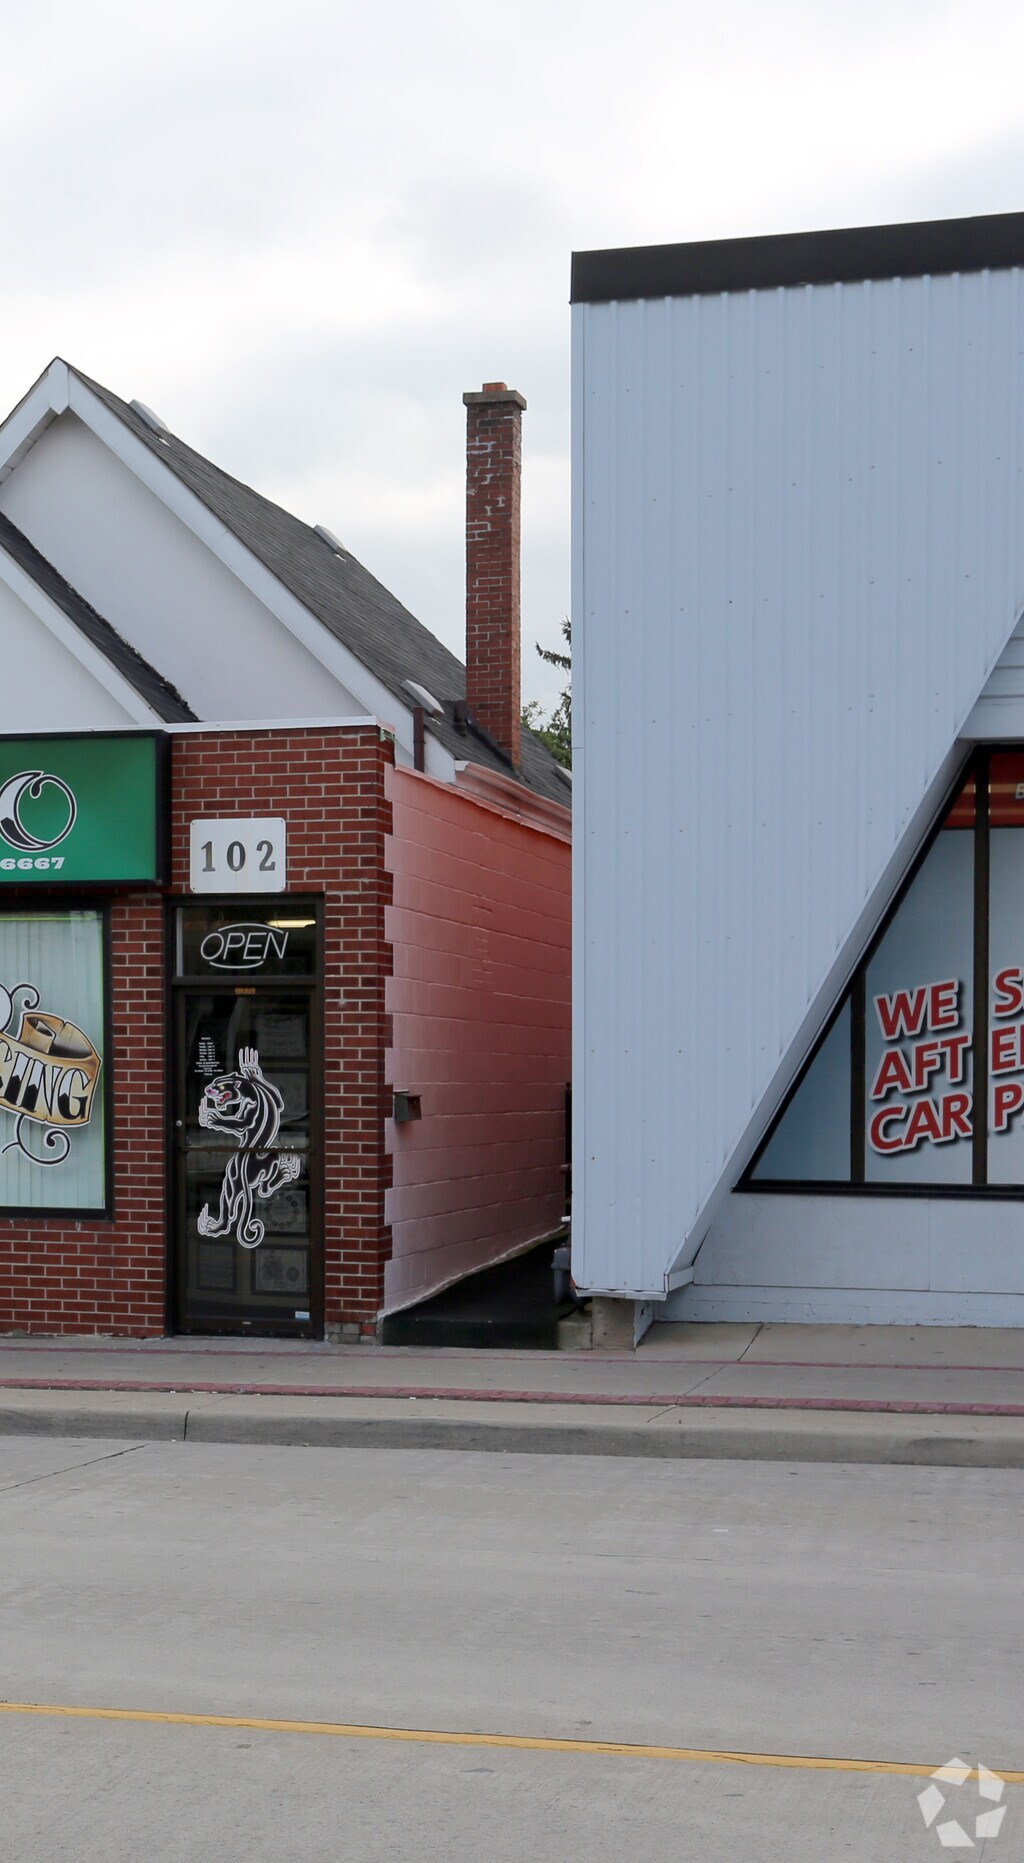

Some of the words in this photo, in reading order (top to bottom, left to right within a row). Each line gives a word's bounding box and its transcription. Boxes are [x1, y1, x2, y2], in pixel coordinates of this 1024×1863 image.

[201, 840, 275, 872] 102
[200, 931, 289, 960] OPEN
[875, 980, 957, 1039] WE
[870, 1093, 972, 1150] CAR
